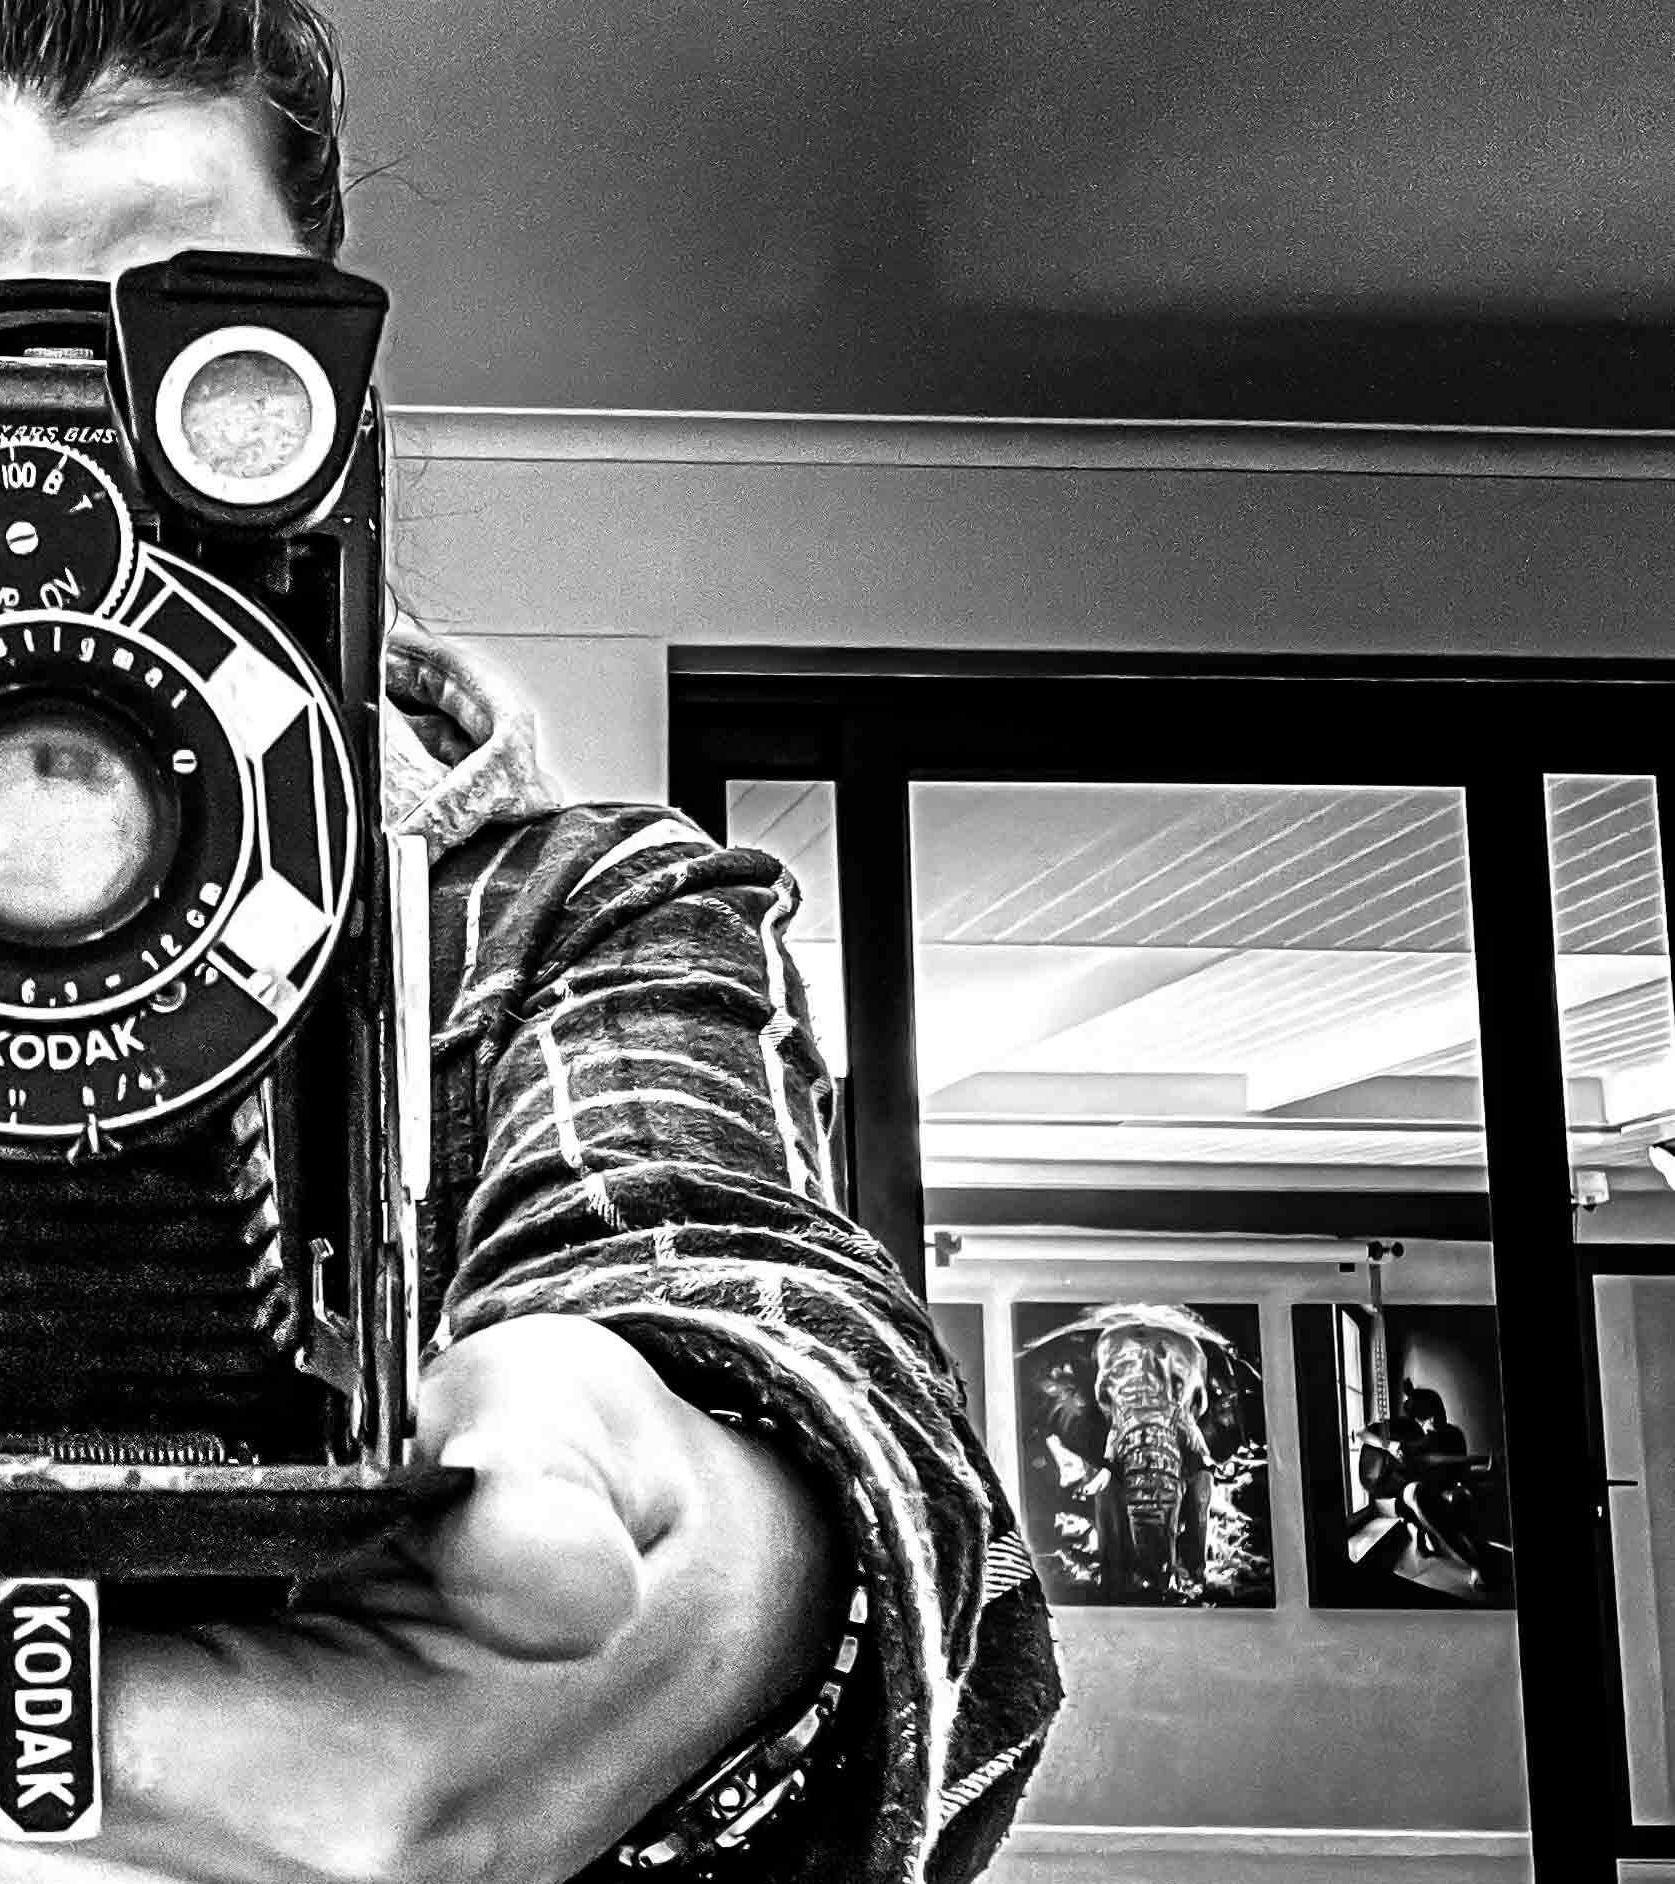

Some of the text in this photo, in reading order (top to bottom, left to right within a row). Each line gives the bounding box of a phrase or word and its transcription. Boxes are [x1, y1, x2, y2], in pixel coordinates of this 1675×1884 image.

[64, 426, 119, 444] GLAS
[1, 461, 37, 489] 100
[42, 469, 65, 495] B
